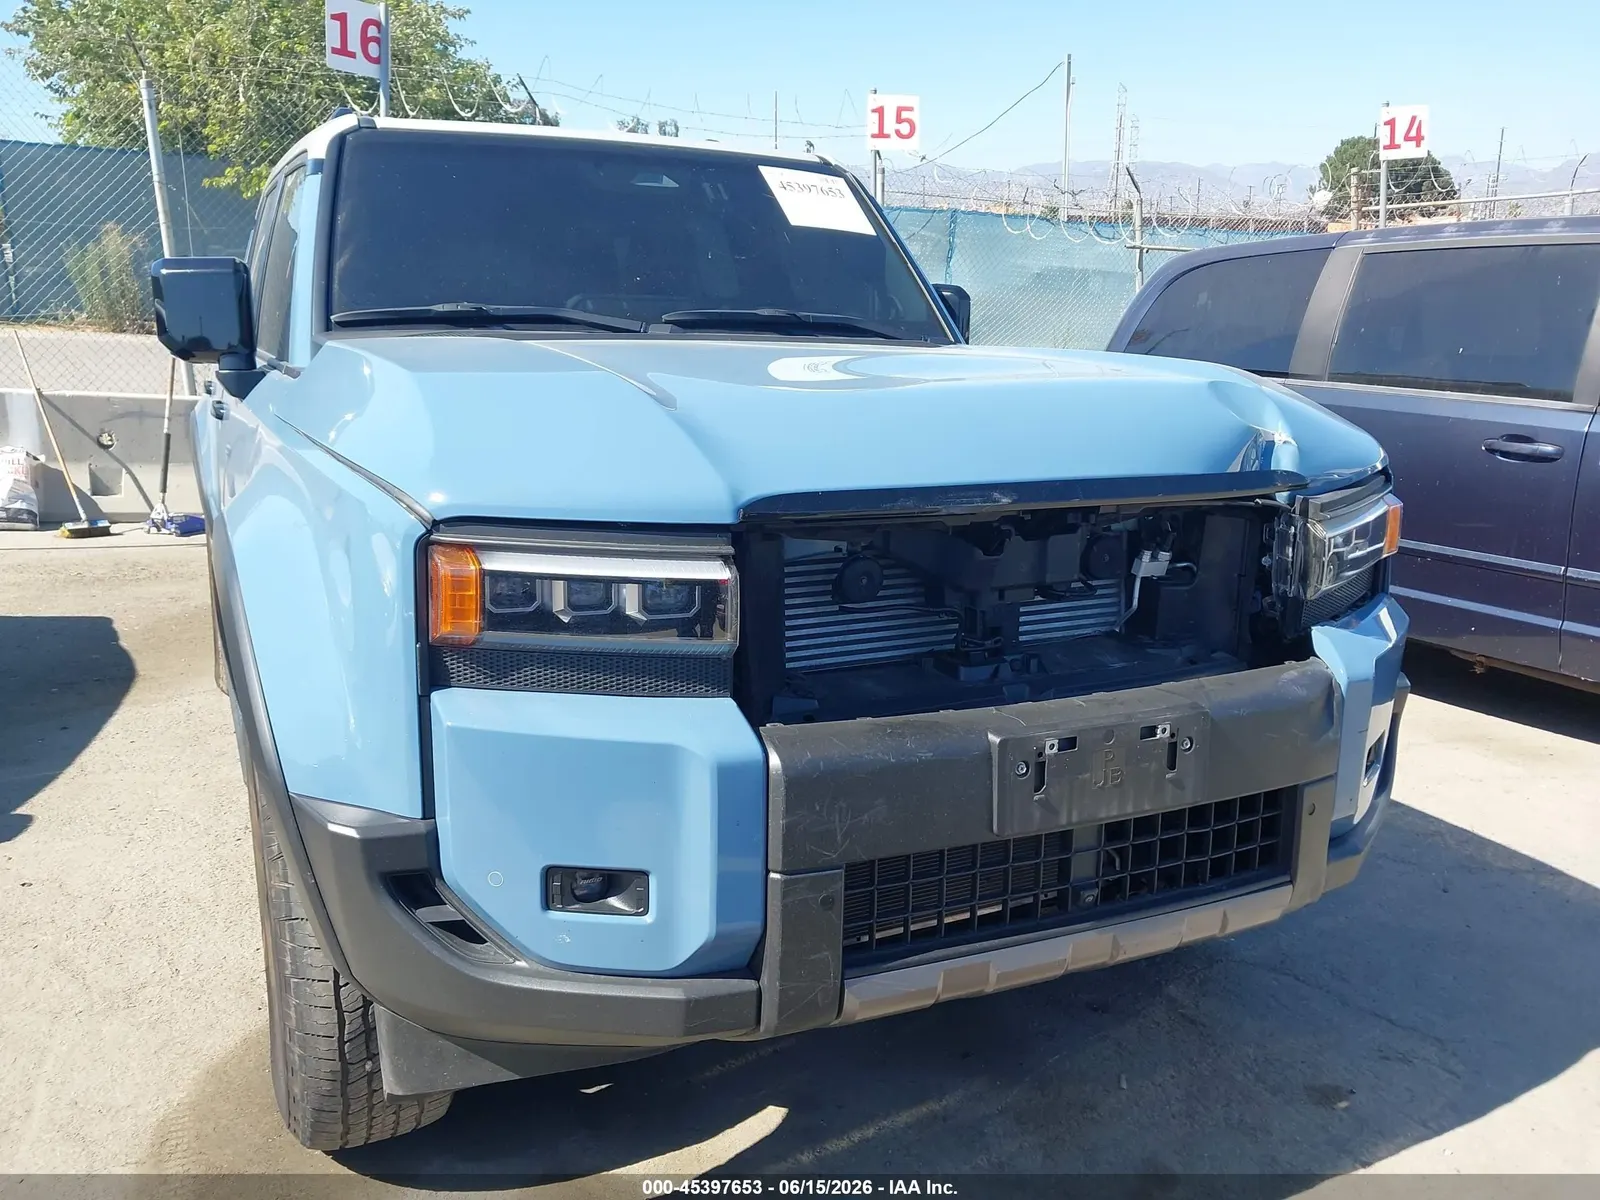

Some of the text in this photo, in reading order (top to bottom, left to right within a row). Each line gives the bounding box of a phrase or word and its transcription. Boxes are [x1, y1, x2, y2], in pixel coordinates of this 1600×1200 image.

[330, 11, 382, 65] 16
[870, 105, 917, 140] 15
[1382, 114, 1425, 151] 14
[778, 180, 846, 199] 45397653
